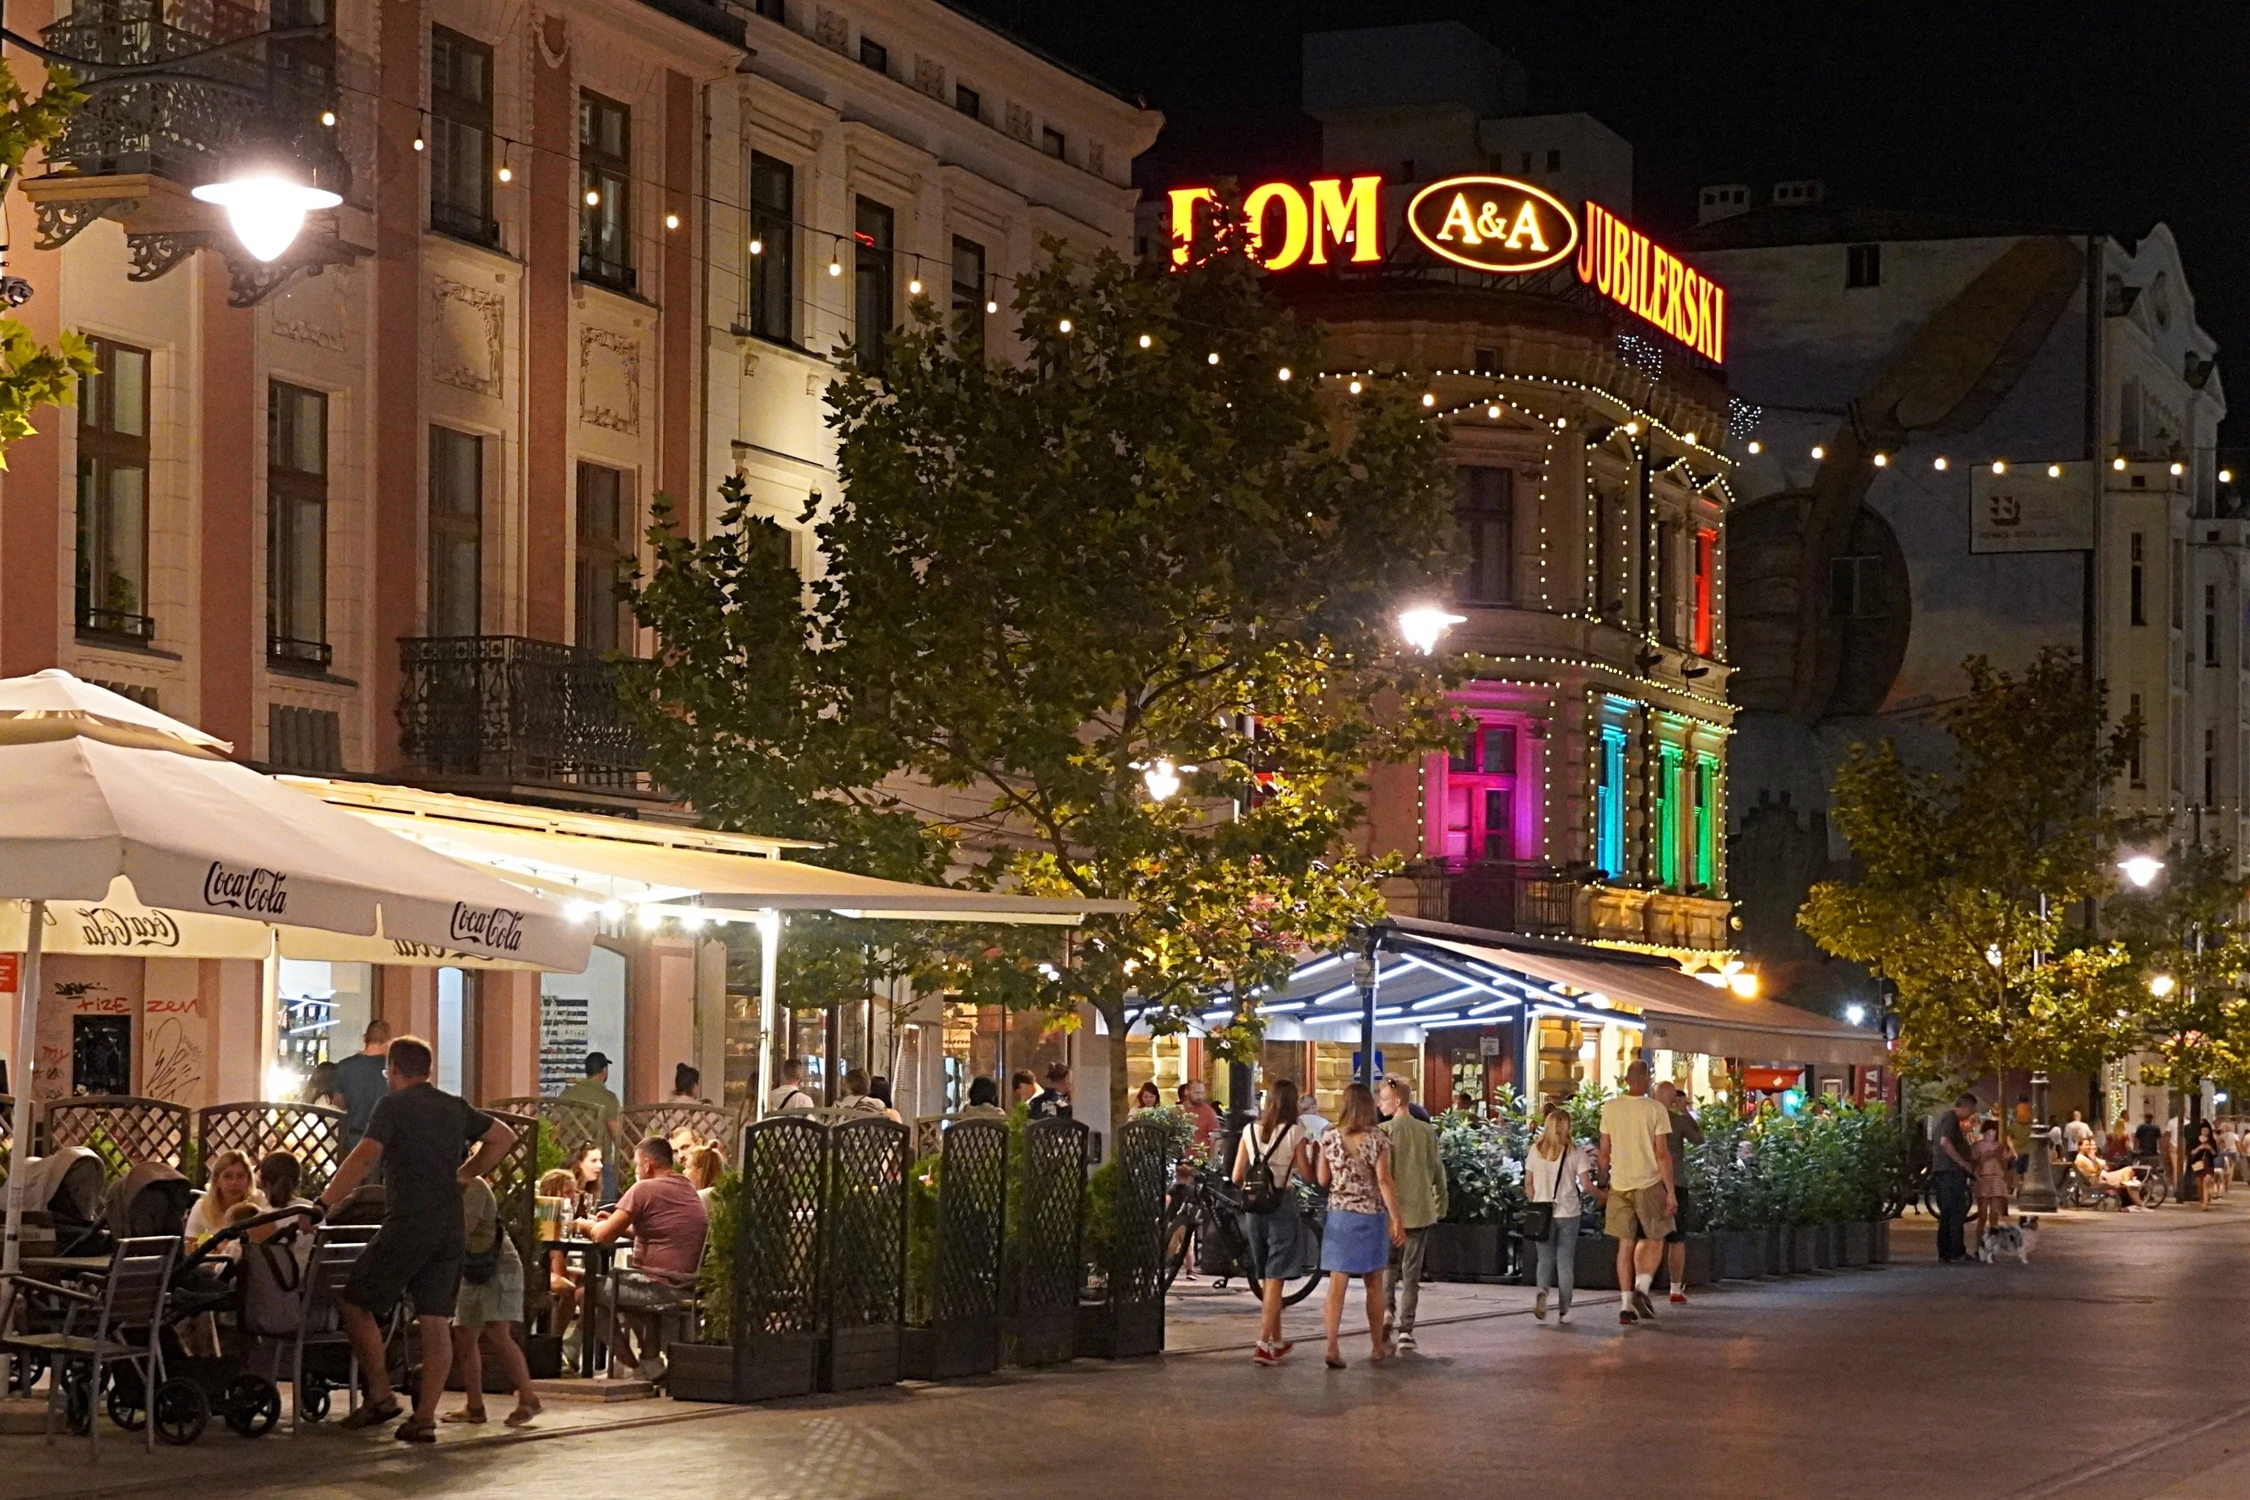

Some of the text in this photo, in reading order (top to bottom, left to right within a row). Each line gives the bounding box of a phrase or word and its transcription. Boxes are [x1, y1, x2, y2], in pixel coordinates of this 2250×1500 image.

[1436, 192, 1549, 252] A&A
[1577, 200, 1724, 365] JUBILERSKI
[203, 860, 287, 915] Coca-Cola
[450, 900, 525, 952] Coca-Cola
